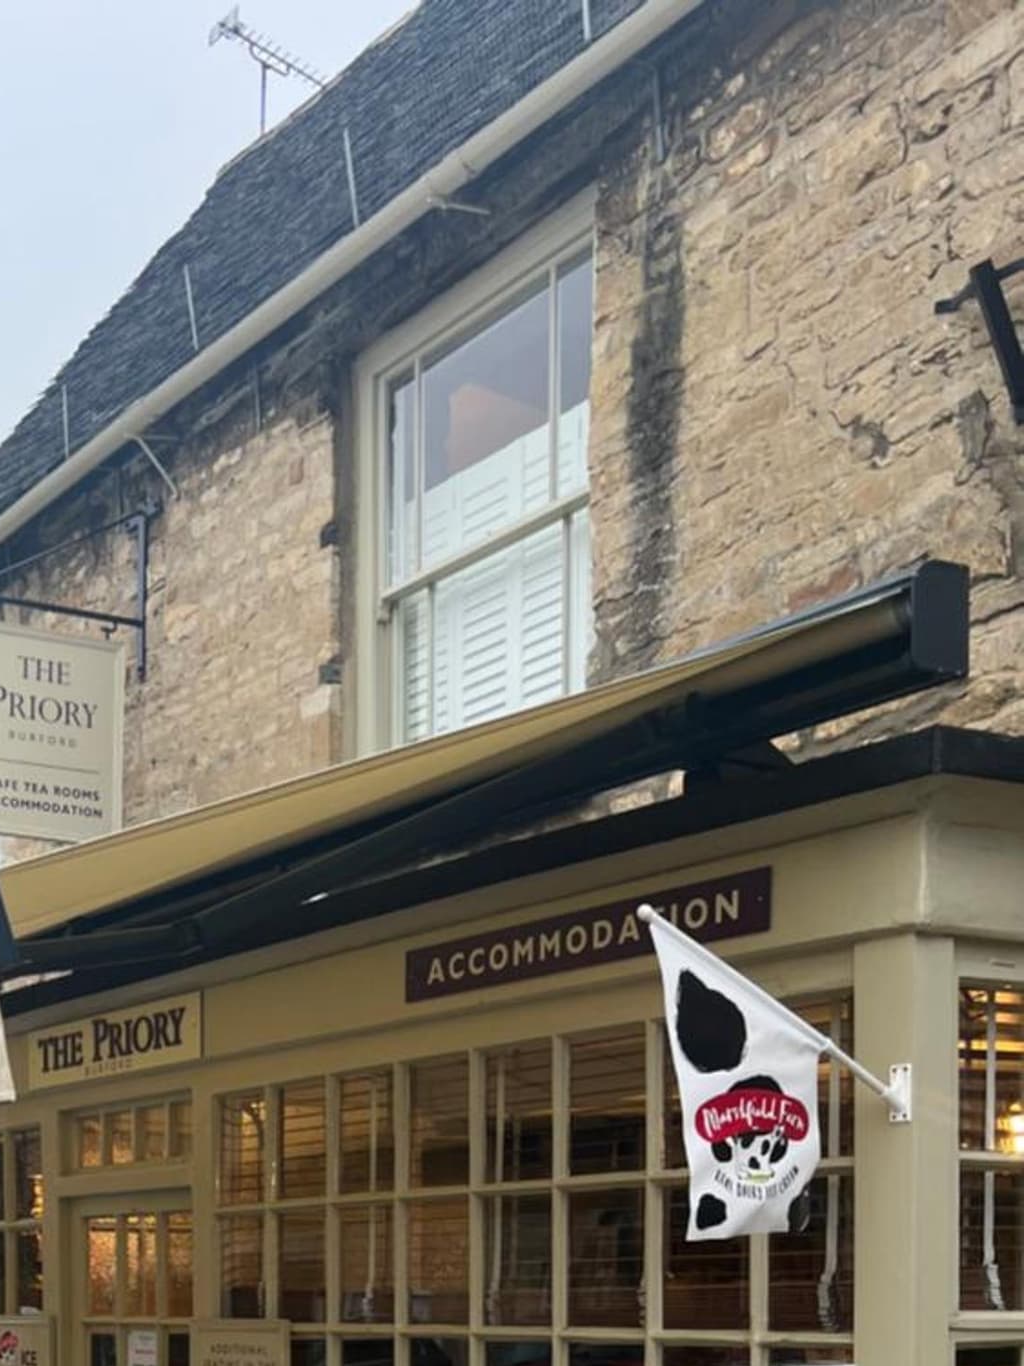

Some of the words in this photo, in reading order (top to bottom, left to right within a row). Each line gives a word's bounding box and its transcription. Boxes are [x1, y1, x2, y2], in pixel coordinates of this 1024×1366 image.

[17, 655, 71, 686] THE
[8, 730, 78, 748] BURFORD
[23, 781, 48, 795] TEA
[53, 785, 100, 802] ROOMS
[38, 1030, 83, 1072] THE
[91, 1007, 186, 1063] PRIORY
[21, 1350, 37, 1366] ICE
